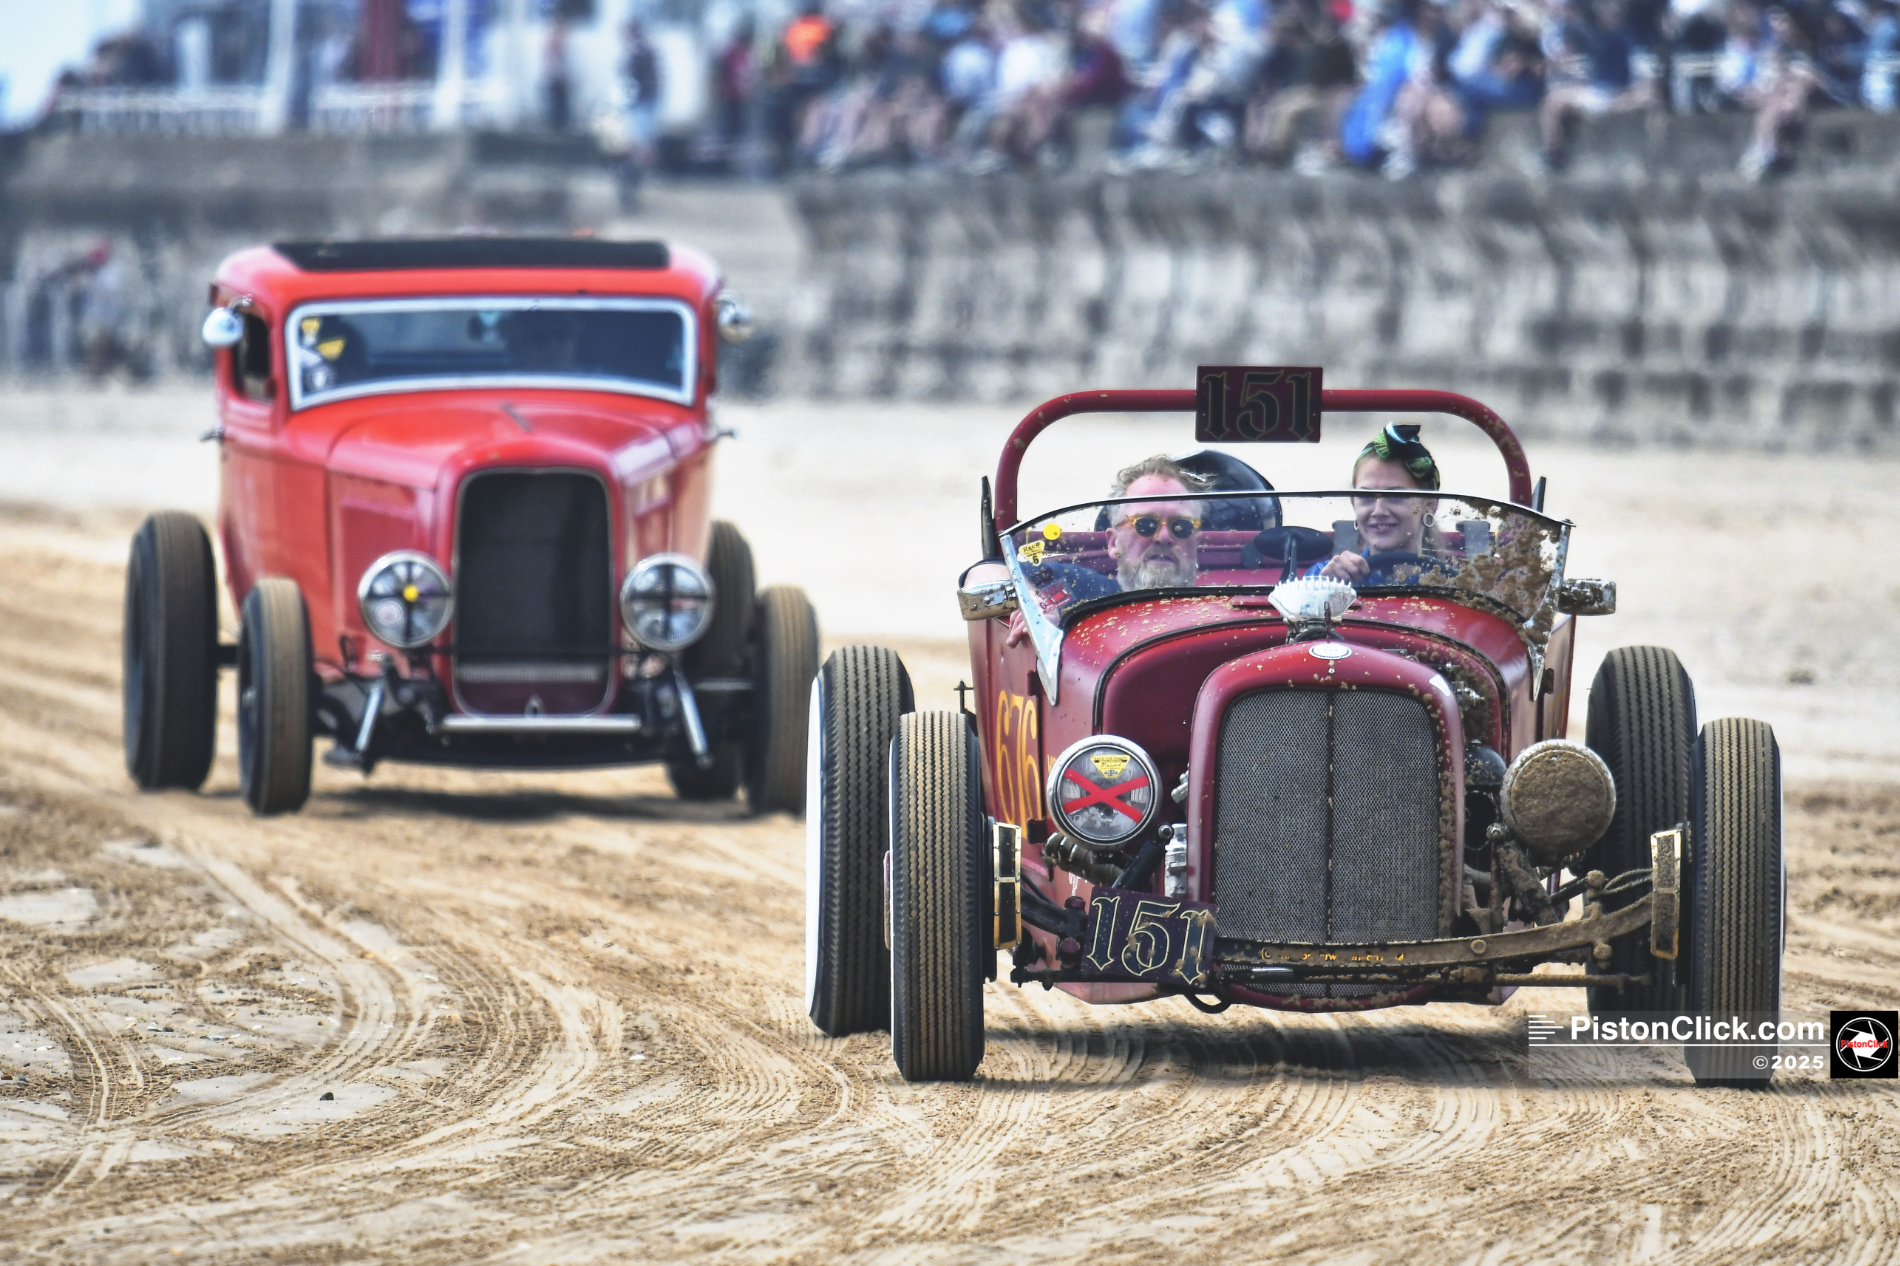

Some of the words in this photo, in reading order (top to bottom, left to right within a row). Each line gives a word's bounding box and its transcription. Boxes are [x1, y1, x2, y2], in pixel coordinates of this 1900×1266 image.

[1201, 369, 1314, 441] 151
[1032, 555, 1040, 565] 6
[996, 690, 1043, 838] 676
[1086, 896, 1209, 985] 151
